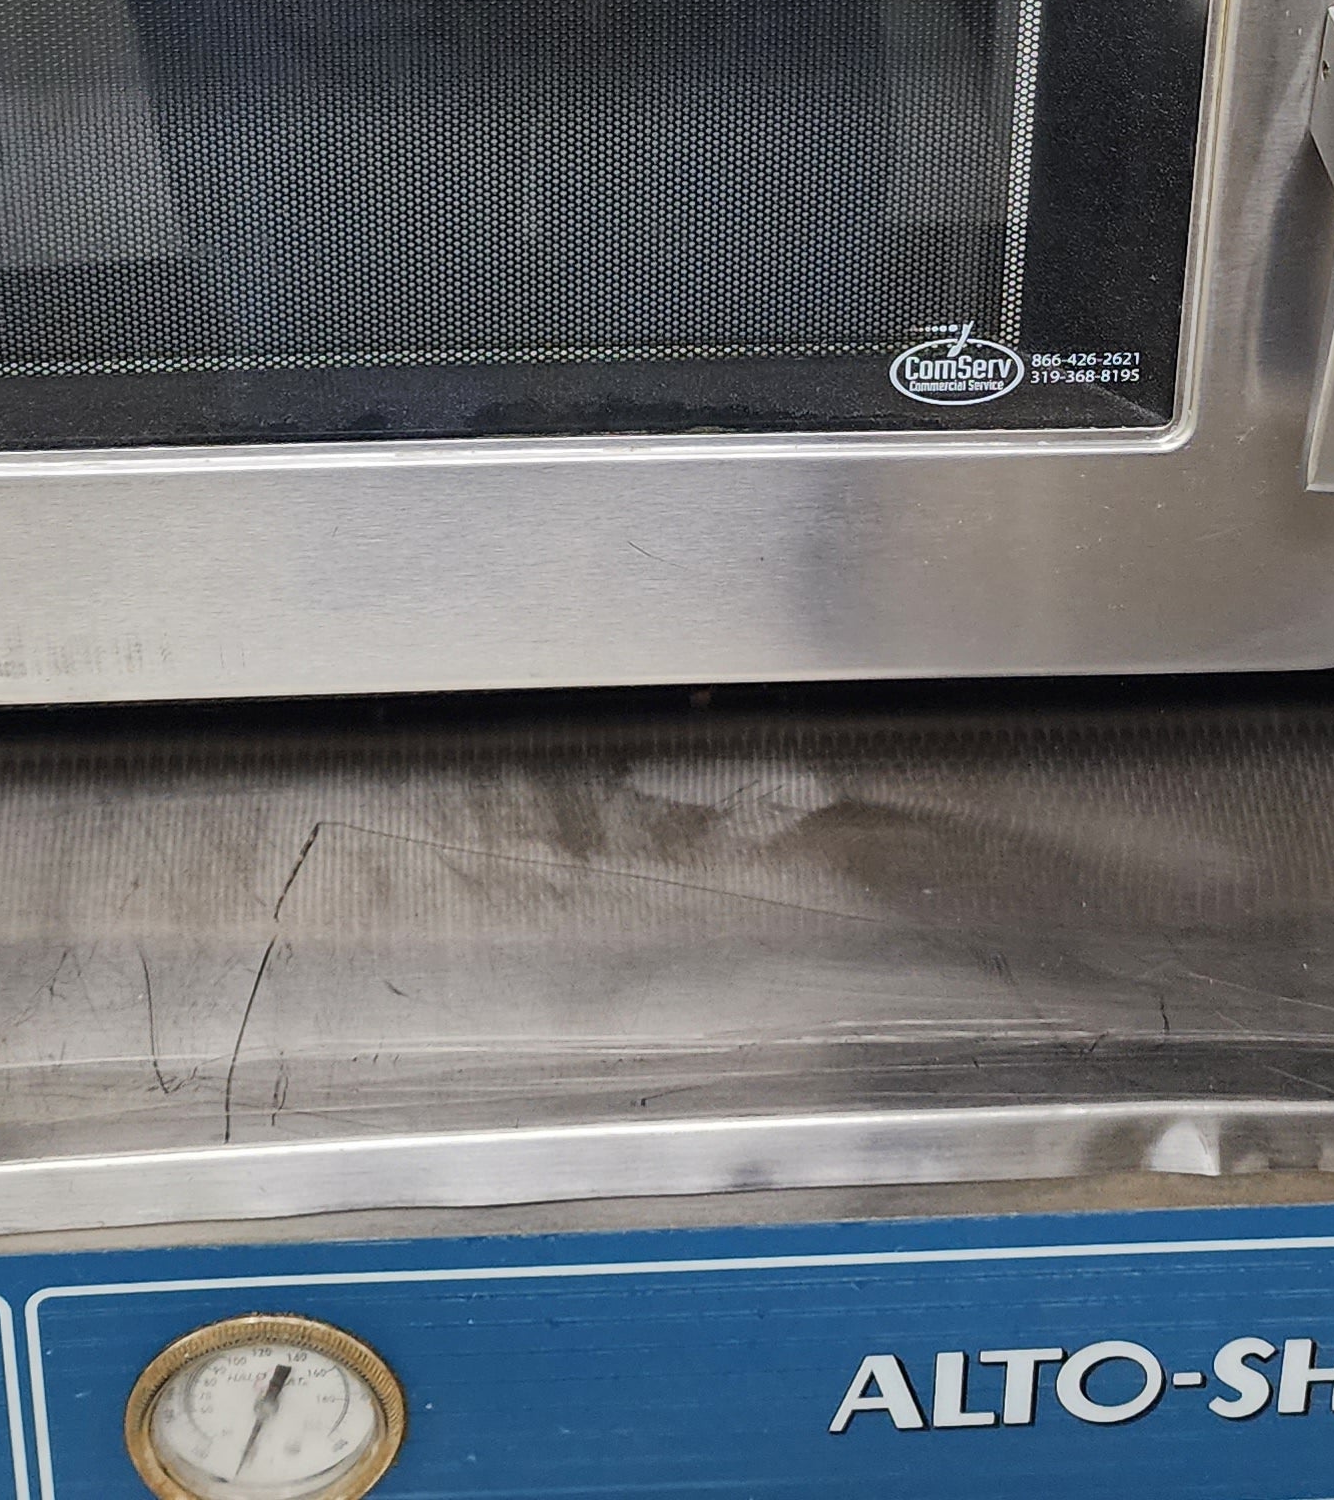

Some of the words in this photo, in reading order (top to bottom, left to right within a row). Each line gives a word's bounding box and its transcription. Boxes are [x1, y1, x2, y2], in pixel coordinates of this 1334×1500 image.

[1031, 352, 1141, 367] 866-426-2621
[904, 355, 1013, 381] ComServ
[1030, 369, 1140, 384] 319-368-8195
[909, 380, 967, 392] Commercial
[967, 380, 1005, 391] Service
